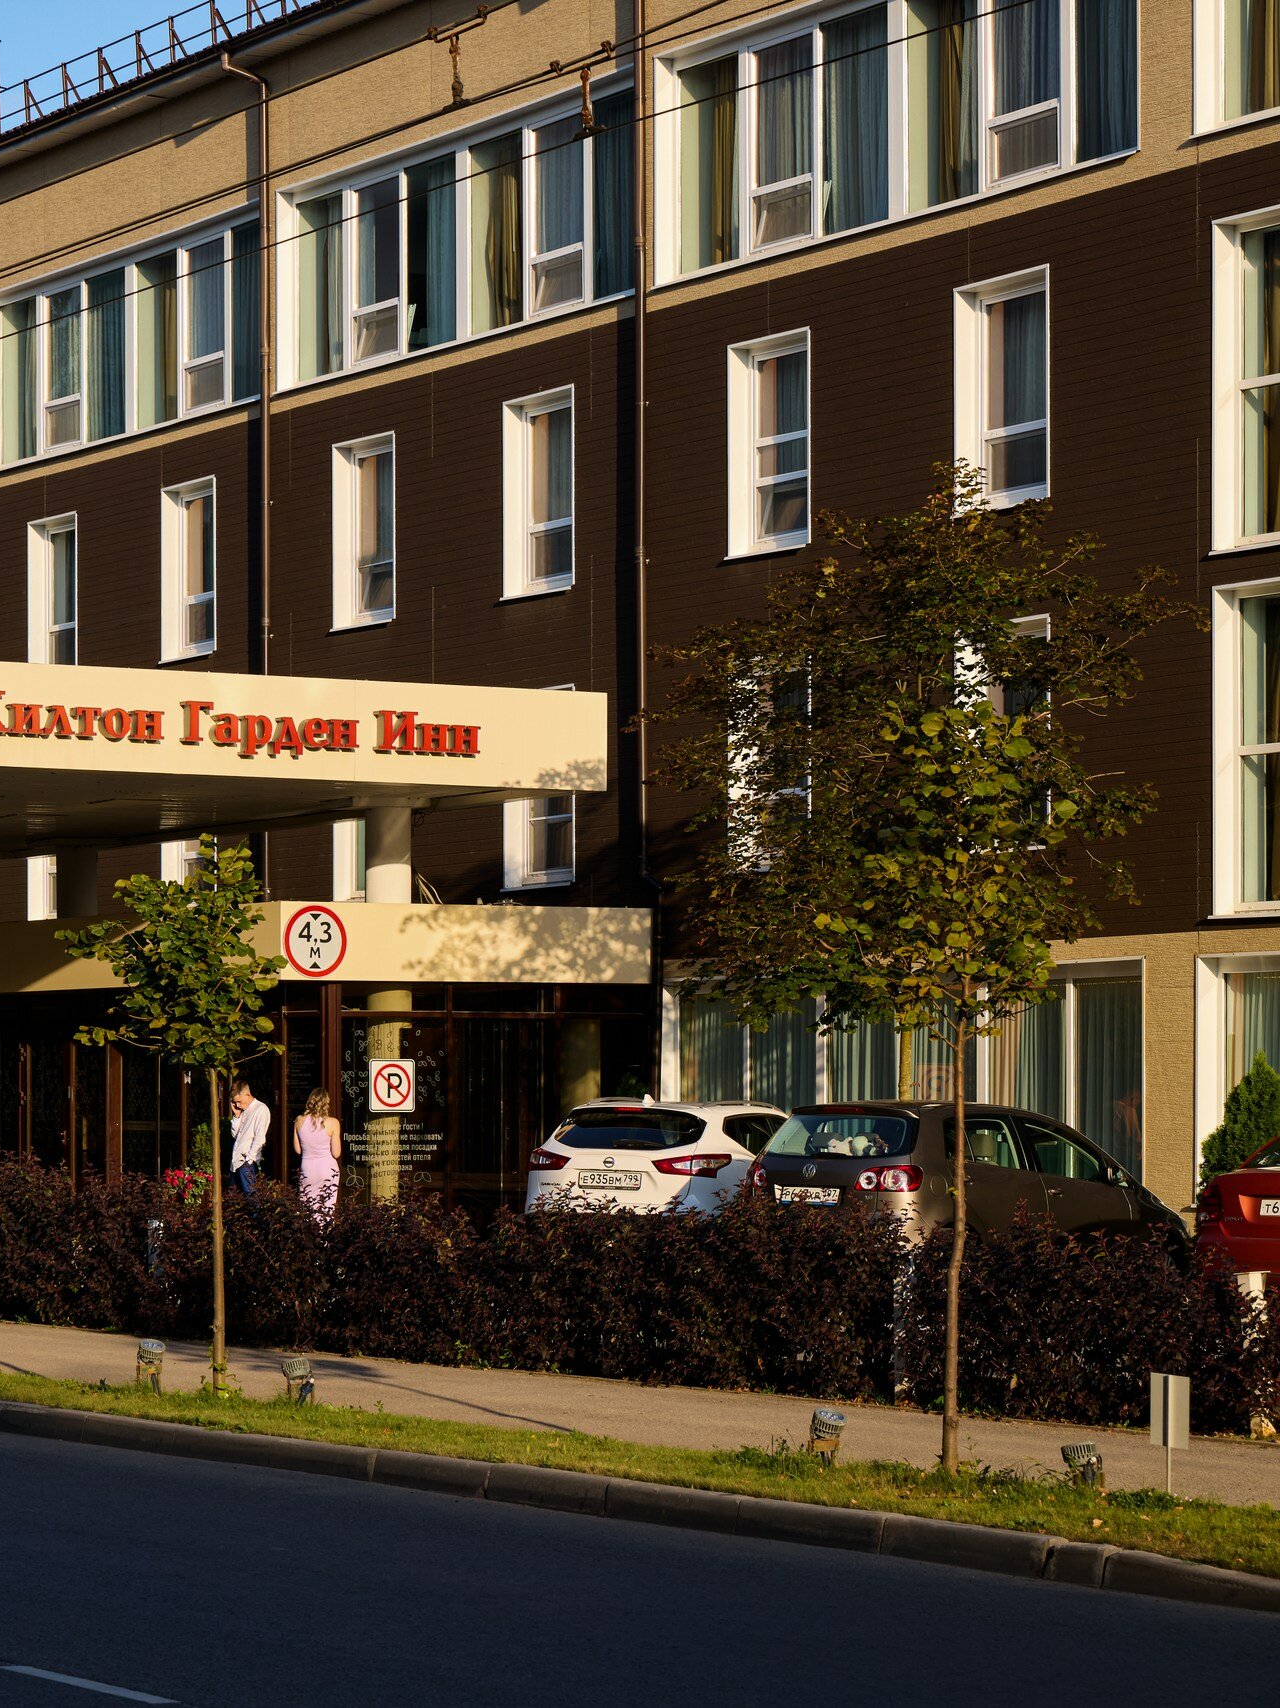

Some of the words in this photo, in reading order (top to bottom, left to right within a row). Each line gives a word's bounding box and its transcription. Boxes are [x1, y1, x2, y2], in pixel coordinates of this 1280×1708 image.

[179, 700, 360, 759] Гарден
[373, 709, 481, 758] Инн
[298, 921, 333, 946] 4,3
